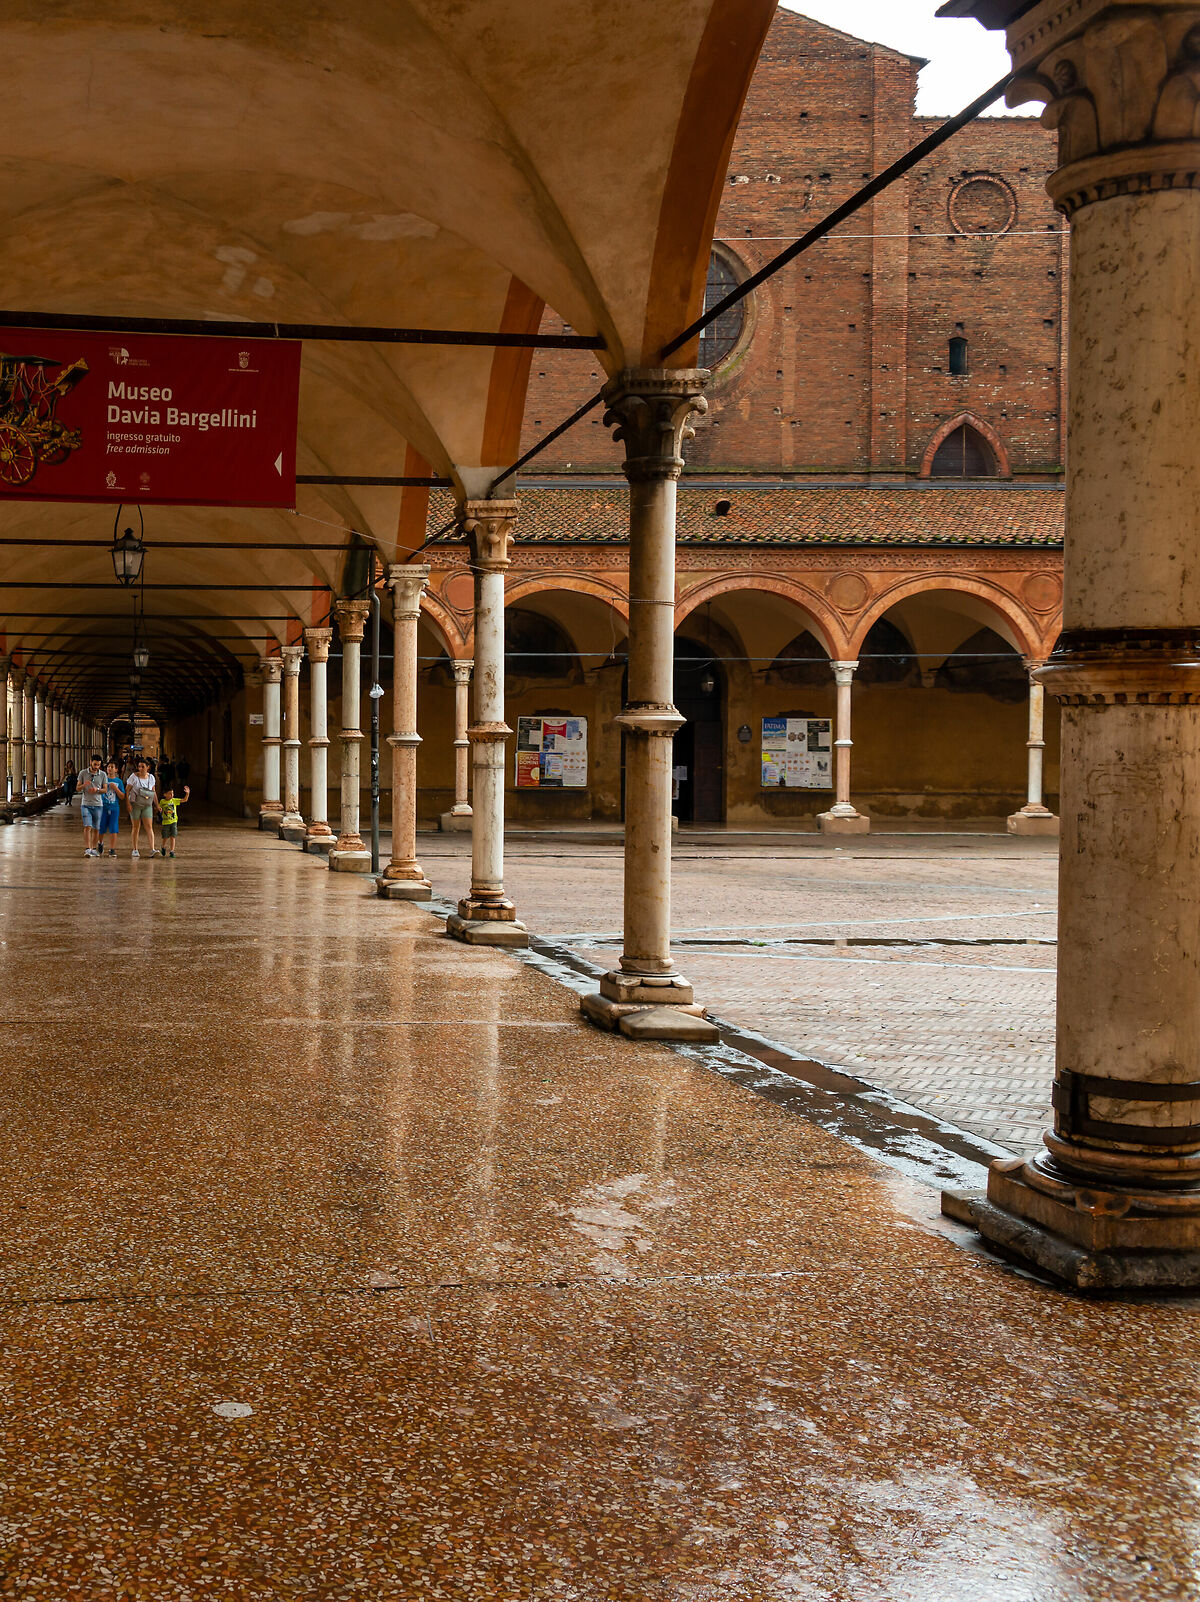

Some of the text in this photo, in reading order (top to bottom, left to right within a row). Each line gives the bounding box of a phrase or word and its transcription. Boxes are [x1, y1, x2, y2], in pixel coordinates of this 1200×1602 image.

[107, 381, 173, 402] Museo
[107, 405, 257, 431] Davia Bargellini
[106, 431, 181, 443] ingresso gratuito
[106, 443, 170, 455] free admission
